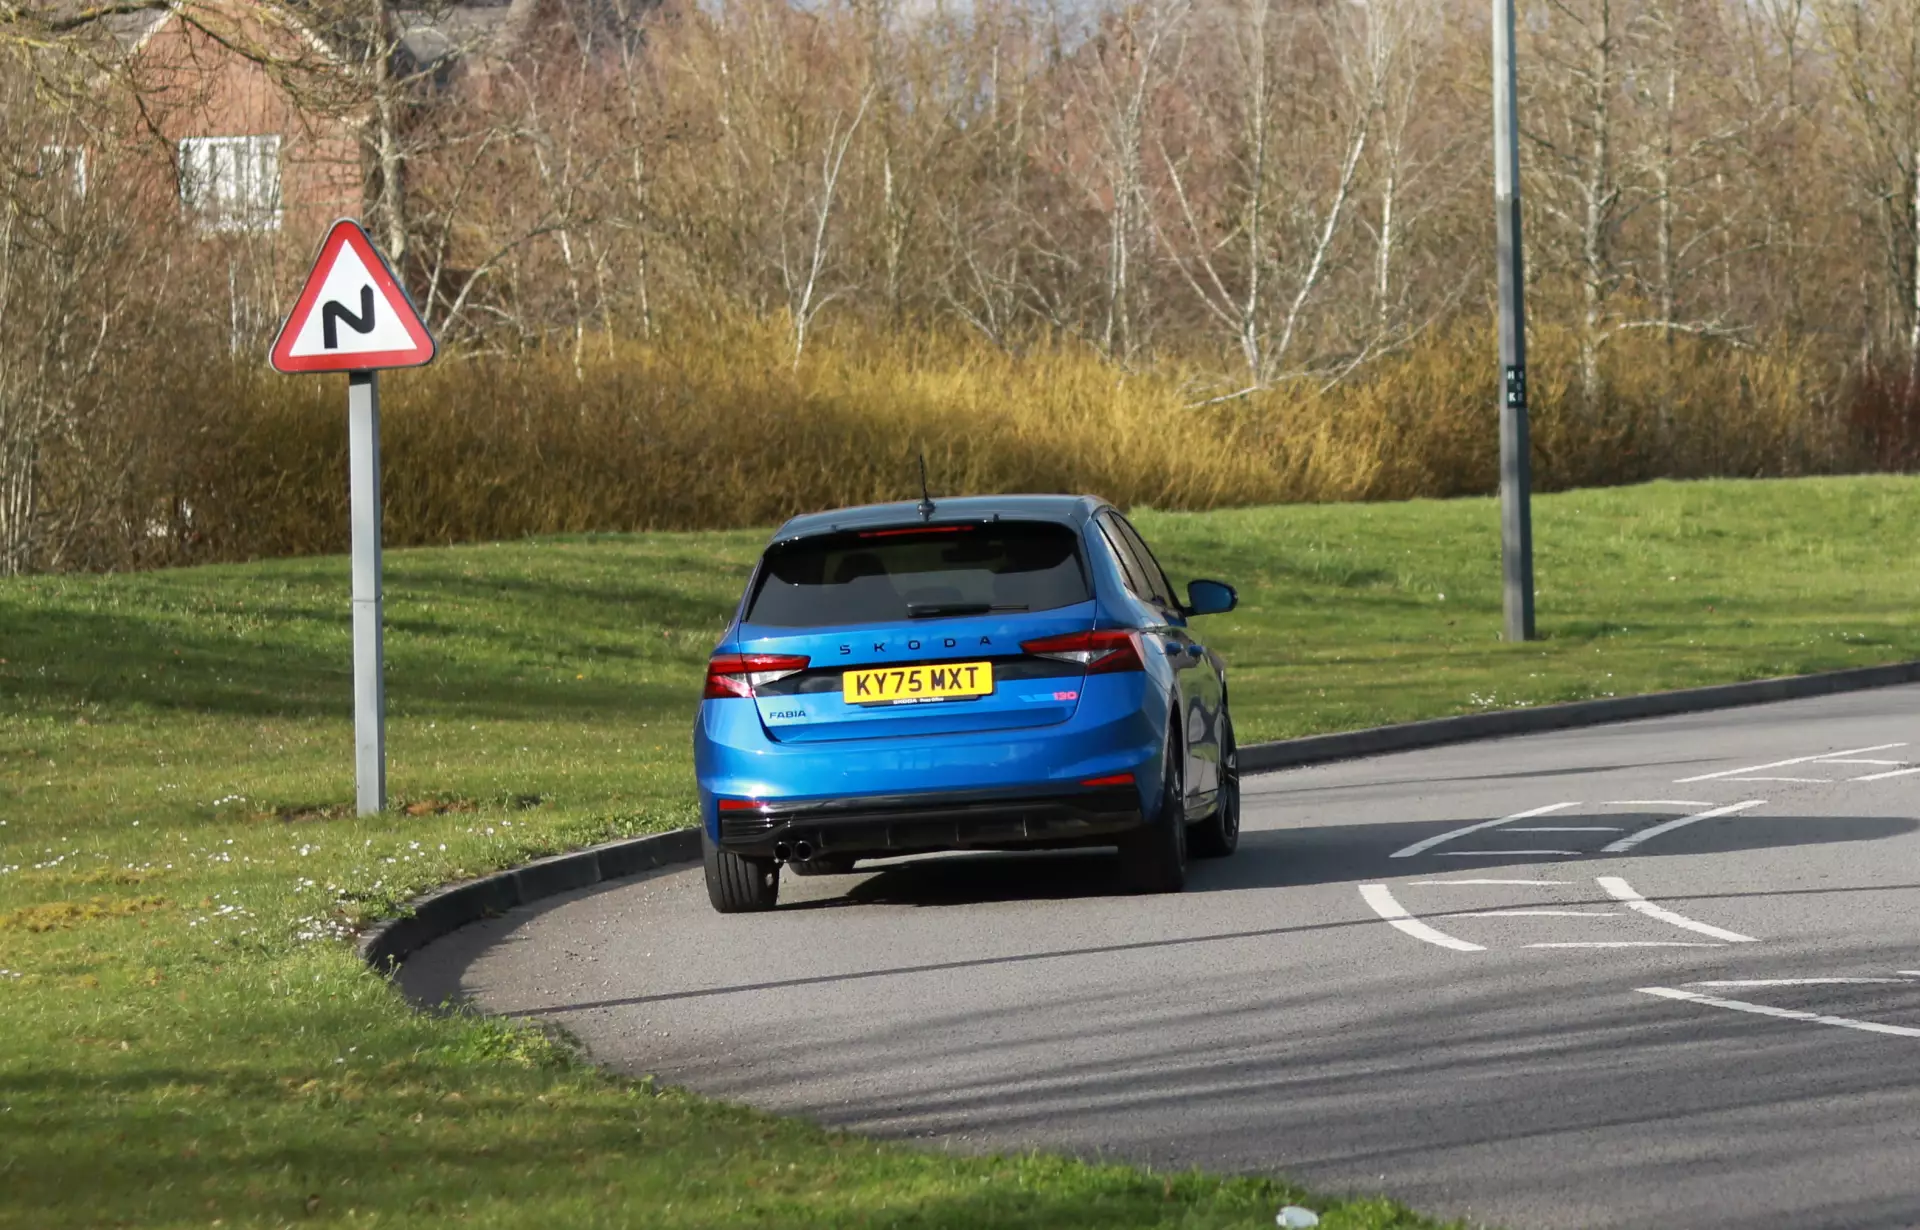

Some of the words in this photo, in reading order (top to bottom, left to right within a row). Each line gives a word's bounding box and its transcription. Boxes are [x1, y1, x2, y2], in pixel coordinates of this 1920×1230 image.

[839, 635, 992, 656] SKODA
[856, 670, 922, 696] KY75
[930, 666, 979, 691] MXT
[1053, 691, 1077, 701] 130
[769, 709, 806, 719] FABIA
